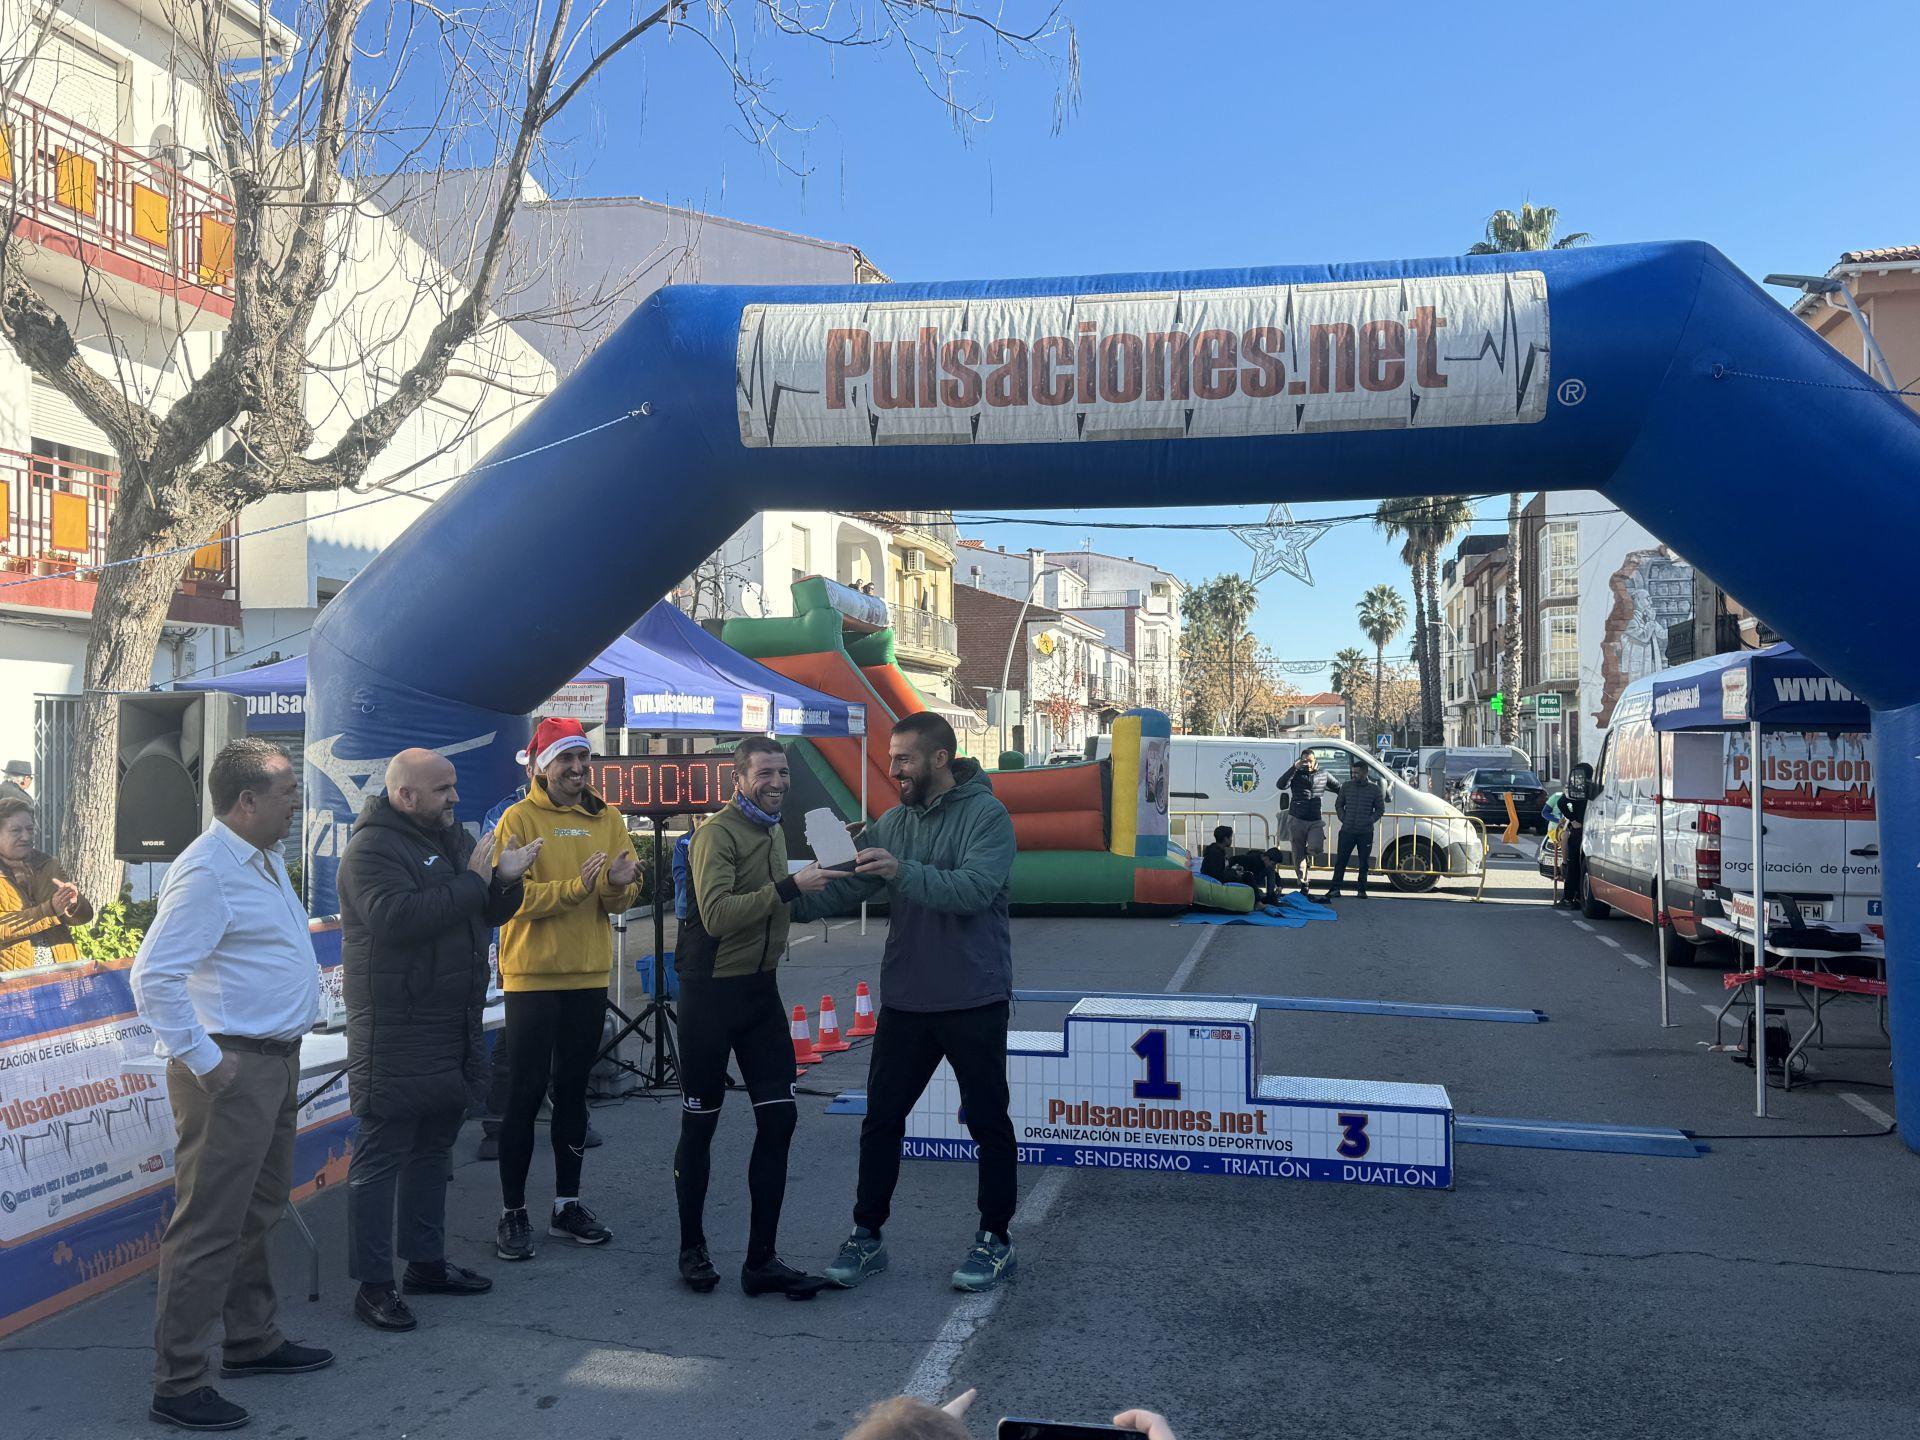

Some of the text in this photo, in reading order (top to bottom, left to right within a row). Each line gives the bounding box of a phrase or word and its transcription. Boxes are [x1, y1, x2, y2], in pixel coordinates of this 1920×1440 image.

[826, 306, 1448, 410] Pulsaciones.net
[633, 691, 715, 715] www.pulsaciones.net
[778, 706, 830, 726] www.pulsaciones.net
[1733, 755, 1875, 782] Plsacion
[1724, 862, 1812, 874] orgaización
[1820, 863, 1838, 874] de
[38, 1047, 54, 1061] DE
[1131, 1029, 1181, 1101] 1
[0, 1073, 157, 1131] ulsaciones.net
[1048, 1098, 1267, 1136] Pulsaciones.net
[1024, 1126, 1293, 1152] ORGANIZACIÓN DE EVENTOS DEPORTIVOS
[1336, 1112, 1370, 1159] 3
[1074, 1149, 1191, 1171] SENDERISMO
[1221, 1157, 1310, 1178] TRIATLÓN
[1343, 1165, 1436, 1186] DUATLÓN
